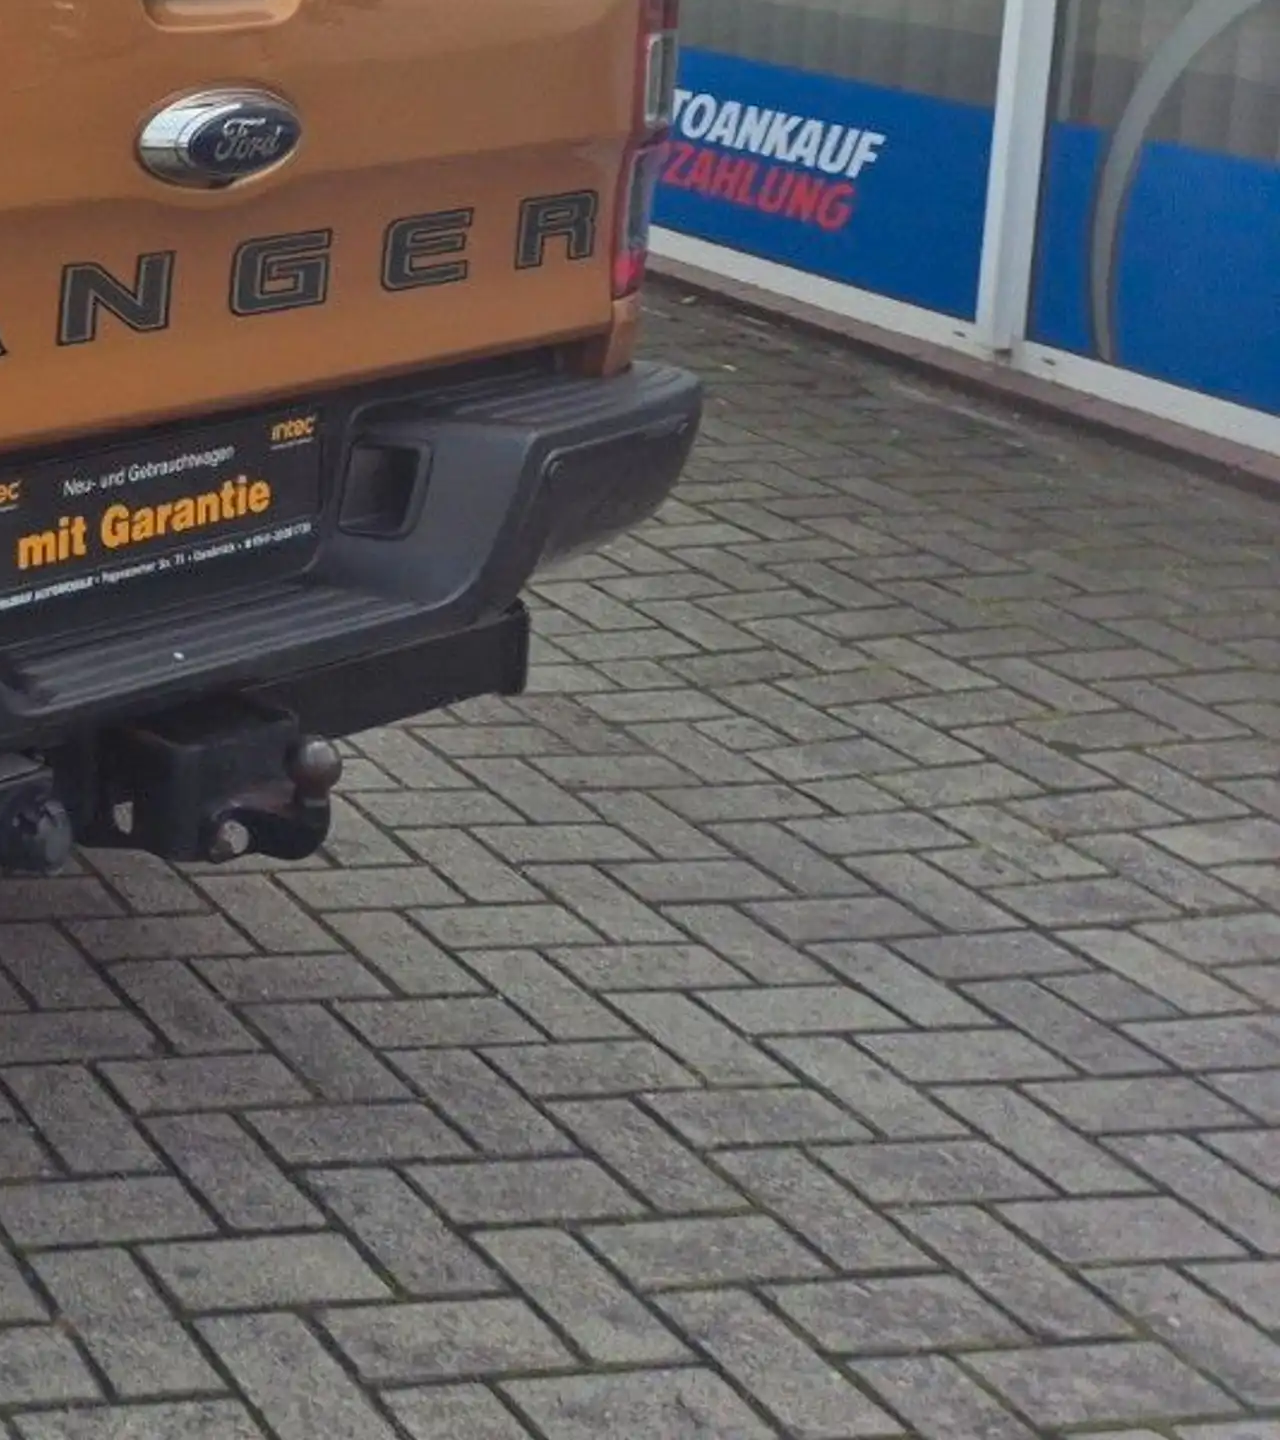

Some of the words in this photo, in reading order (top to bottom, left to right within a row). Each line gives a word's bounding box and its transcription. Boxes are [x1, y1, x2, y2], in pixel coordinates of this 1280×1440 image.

[214, 116, 283, 162] Ford
[662, 141, 857, 231] ZAHLUNG
[270, 413, 317, 442] intec
[62, 475, 95, 498] Neu-
[100, 467, 125, 490] und
[128, 444, 236, 484] Gebrauchtwagen
[17, 515, 87, 571] mit
[100, 475, 272, 550] Garantie
